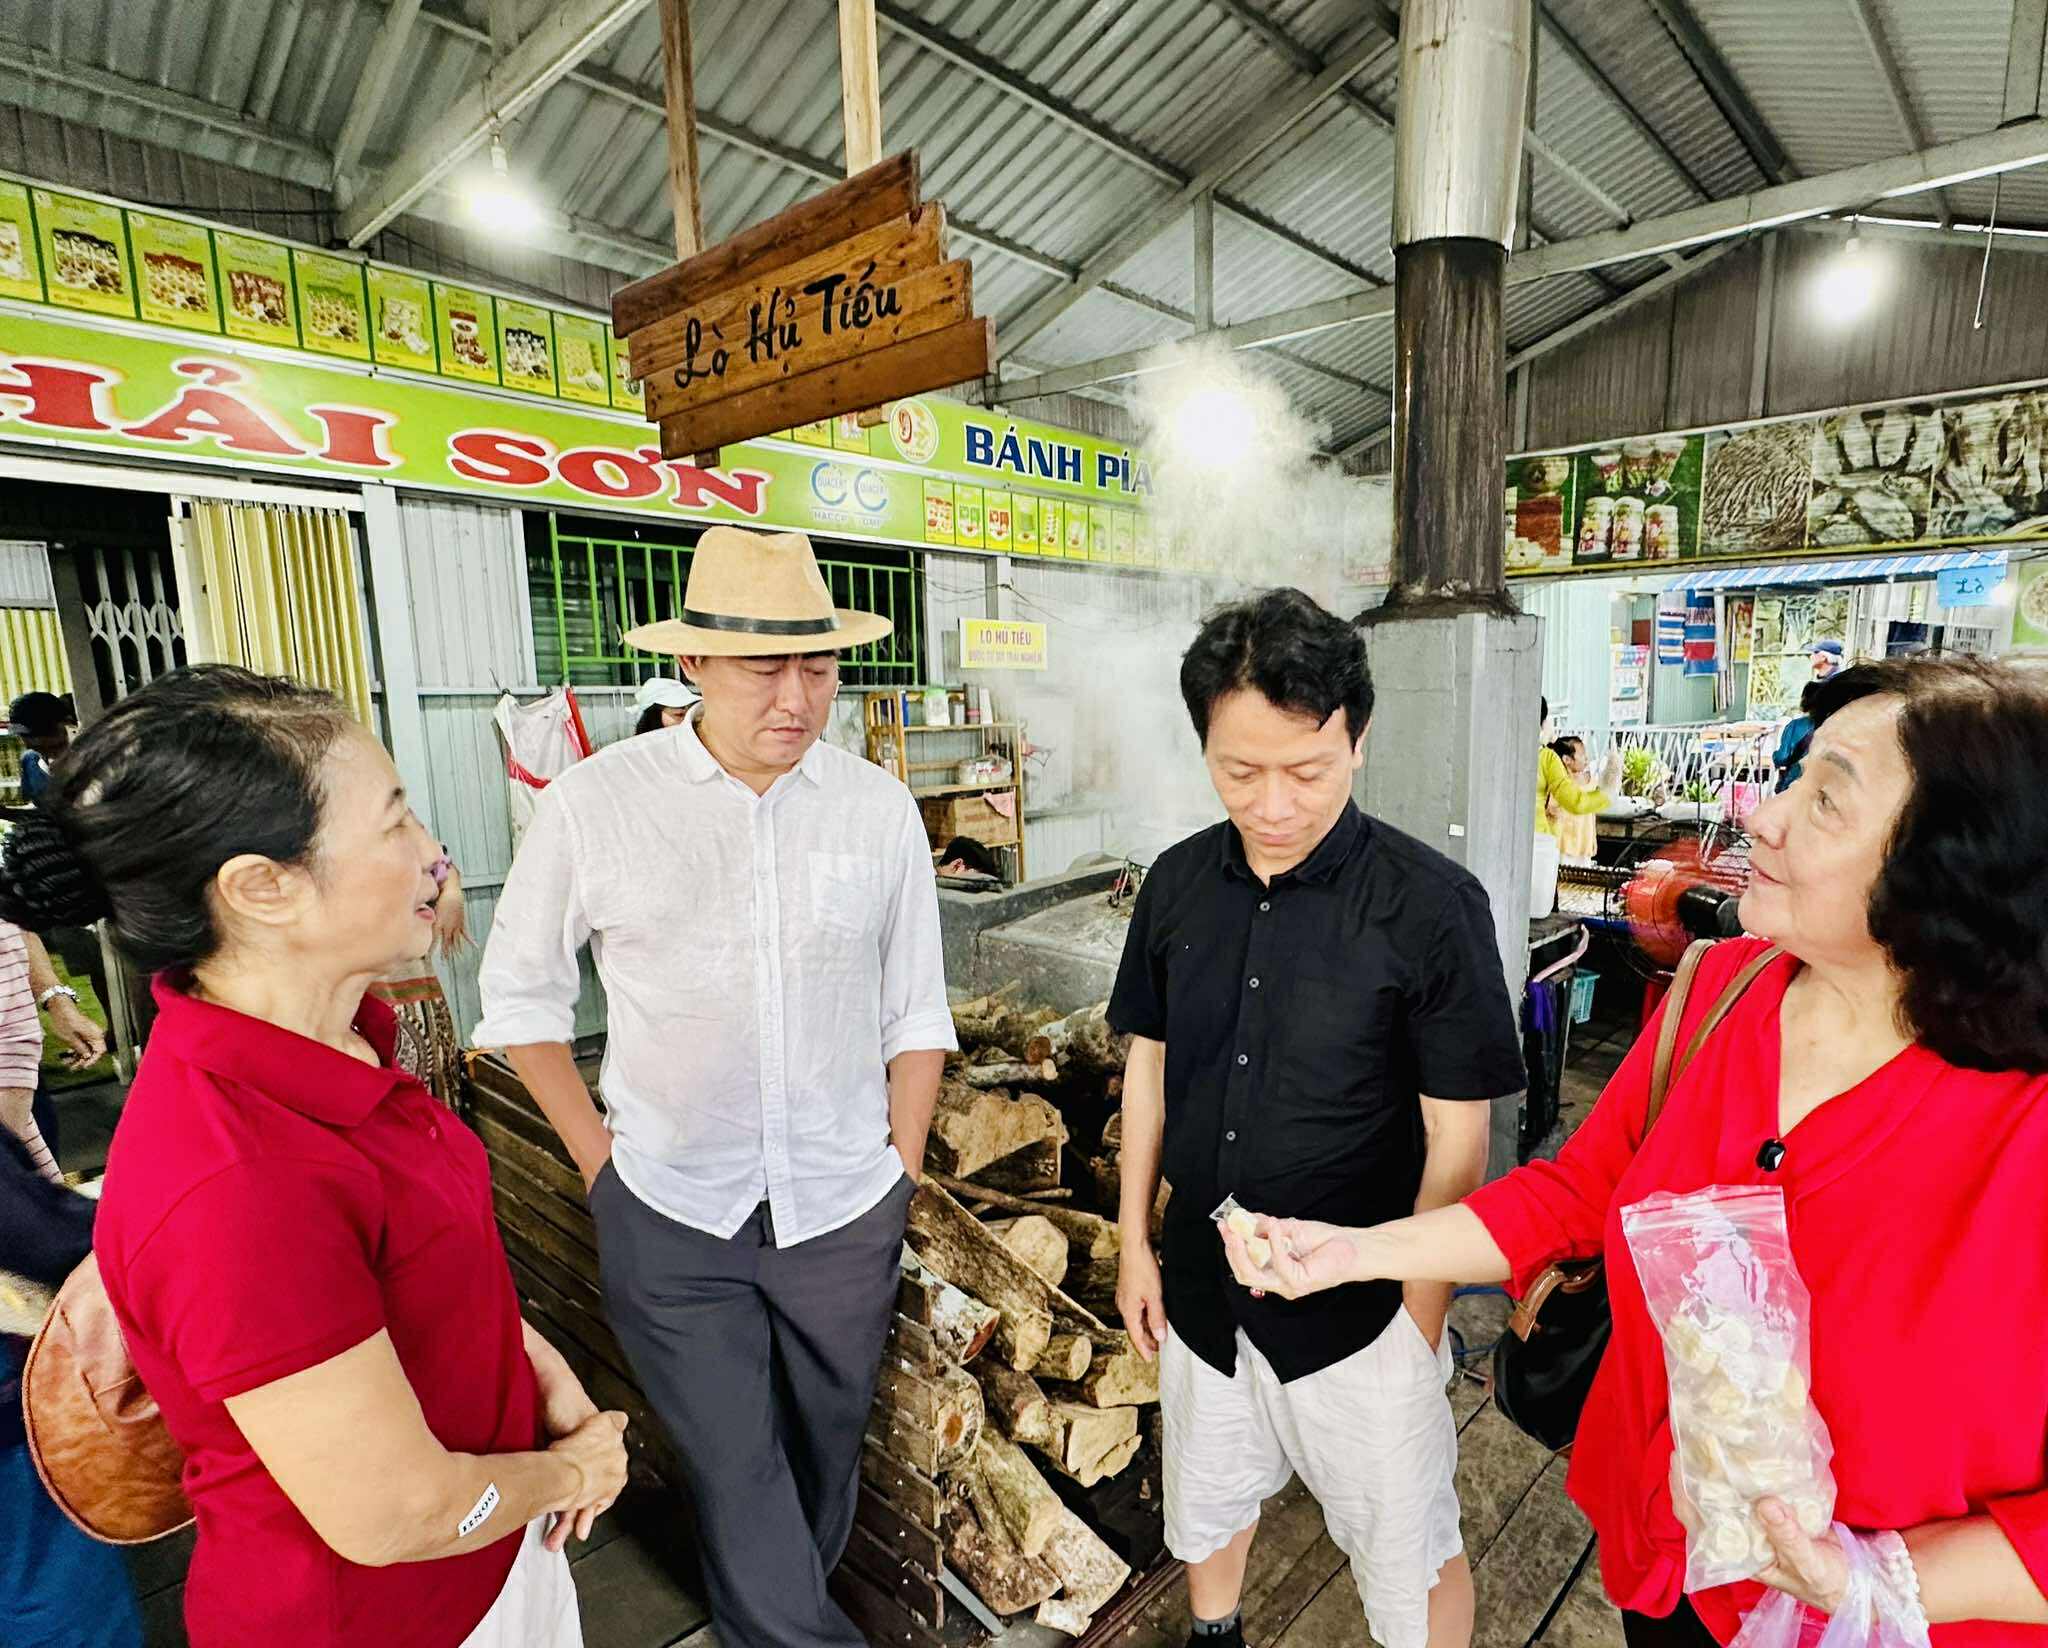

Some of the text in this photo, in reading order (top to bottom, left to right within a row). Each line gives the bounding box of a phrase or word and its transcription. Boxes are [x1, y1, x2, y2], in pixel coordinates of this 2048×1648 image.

[674, 261, 903, 389] Lò Hủ Tiếu
[451, 433, 767, 515] SƠN
[965, 425, 1154, 496] BÁNH PÍA
